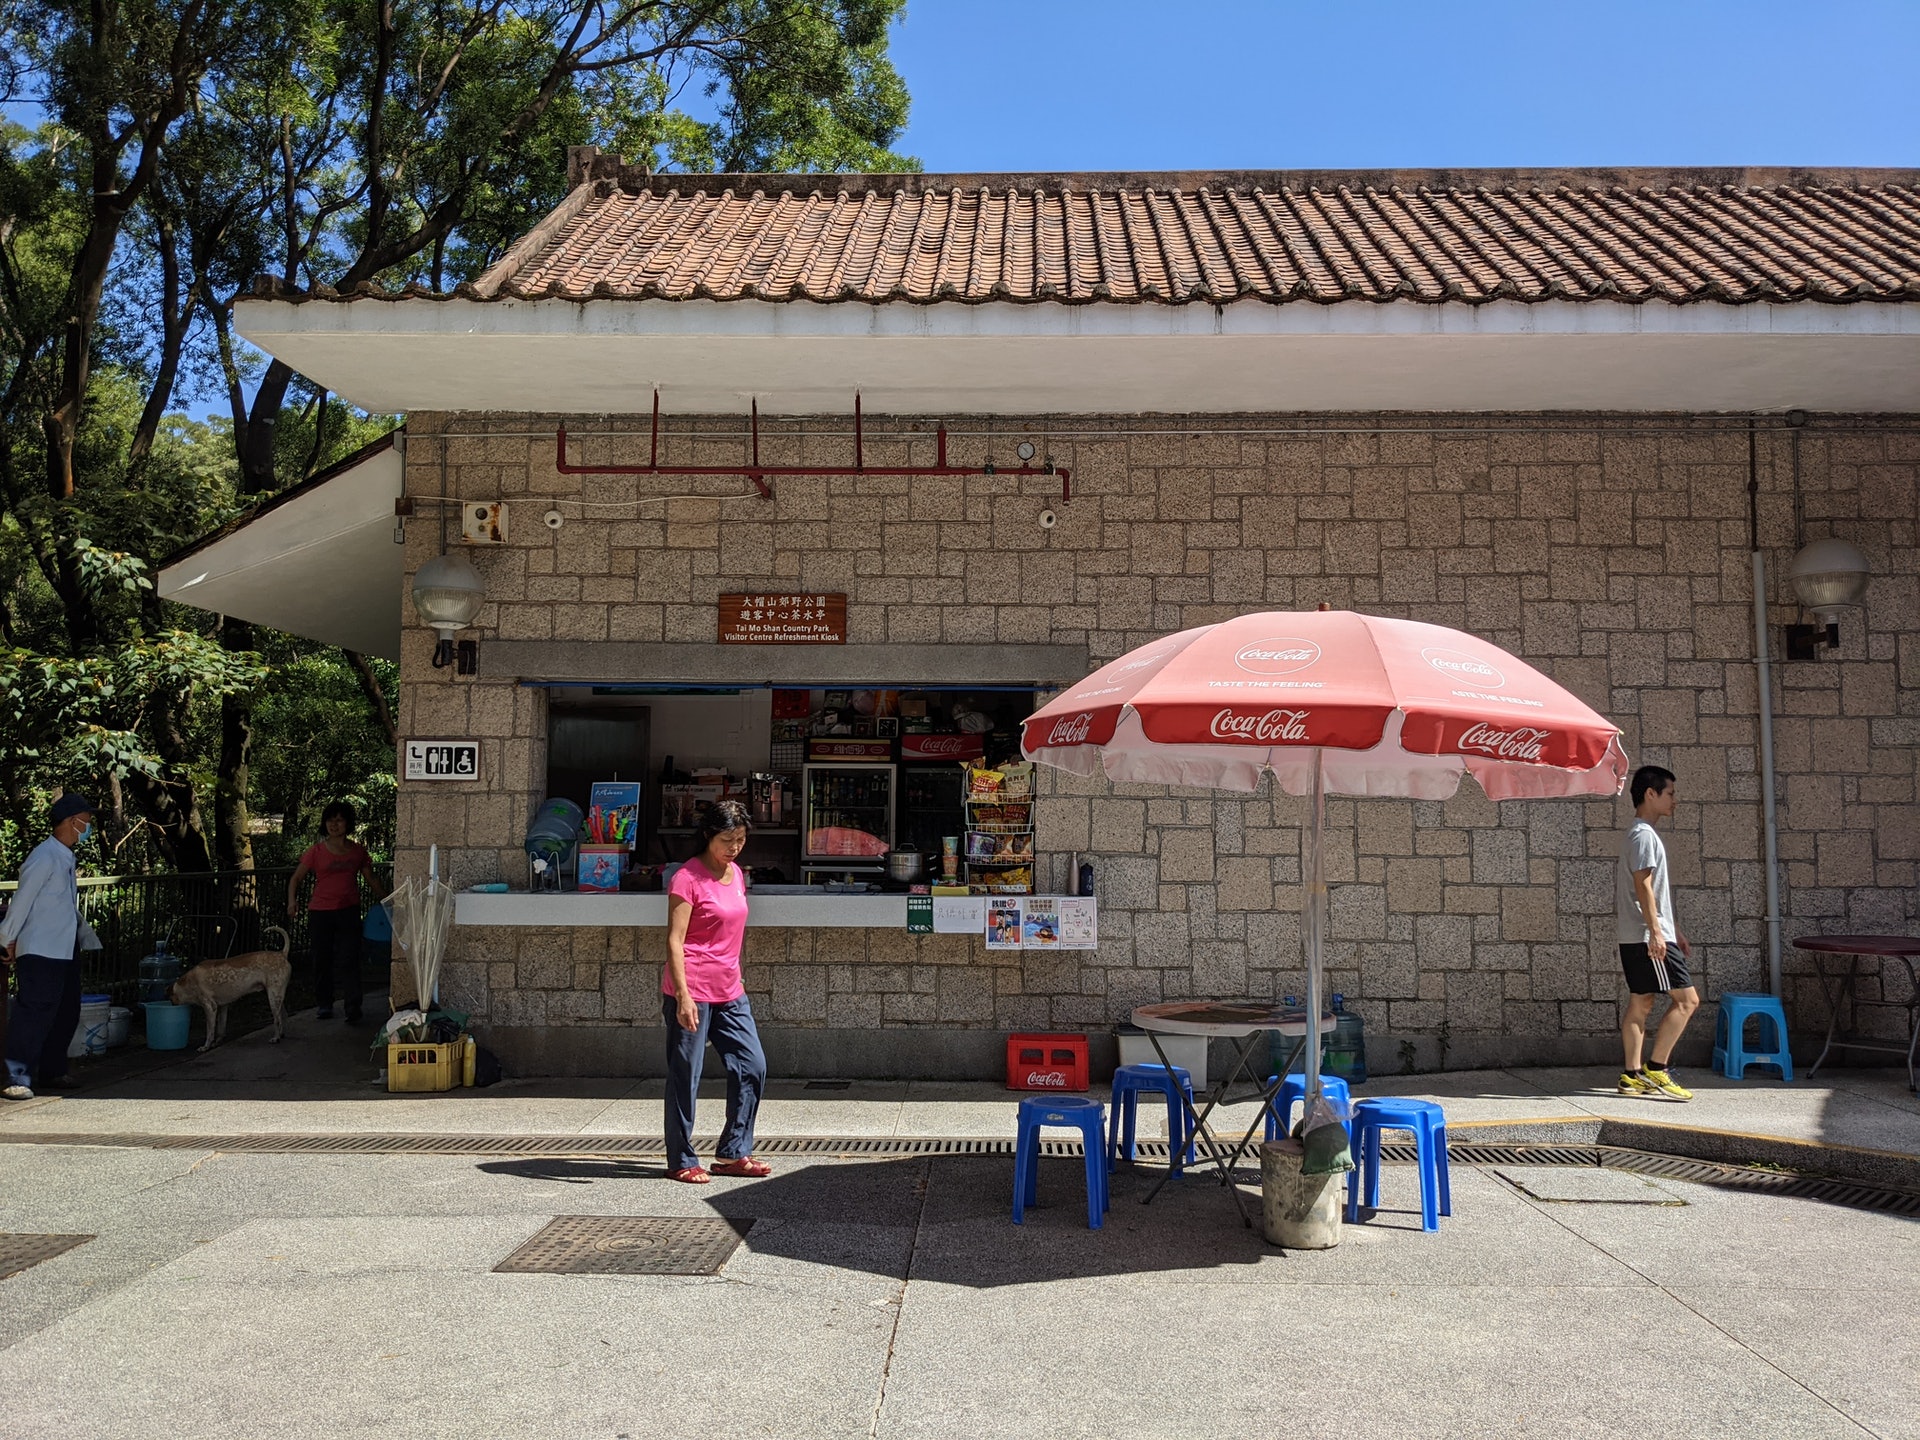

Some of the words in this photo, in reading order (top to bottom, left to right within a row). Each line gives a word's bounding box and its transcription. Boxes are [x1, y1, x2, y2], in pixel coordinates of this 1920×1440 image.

[742, 596, 826, 607] 大帽山郊野公園
[740, 609, 826, 620] 遊客中心茶水亭
[736, 624, 747, 632] Tai
[763, 624, 780, 632] Shan
[782, 624, 812, 633] Country
[813, 624, 829, 632] Park
[725, 633, 748, 641] Visitor
[749, 633, 773, 641] Centre
[774, 633, 819, 641] Refreshment
[820, 633, 839, 641] Kiosk
[1240, 648, 1316, 661] Coca-Cola
[1432, 658, 1493, 675] Coca-Cola
[1272, 681, 1324, 689] FEELING
[1500, 696, 1544, 707] FEELING
[1047, 712, 1095, 745] Coca-Cola
[1210, 708, 1312, 741] Coca-Cola
[920, 737, 964, 754] Coca-Cola
[1457, 721, 1552, 760] Coca-Cola
[1027, 1071, 1067, 1086] Coca-Cola
